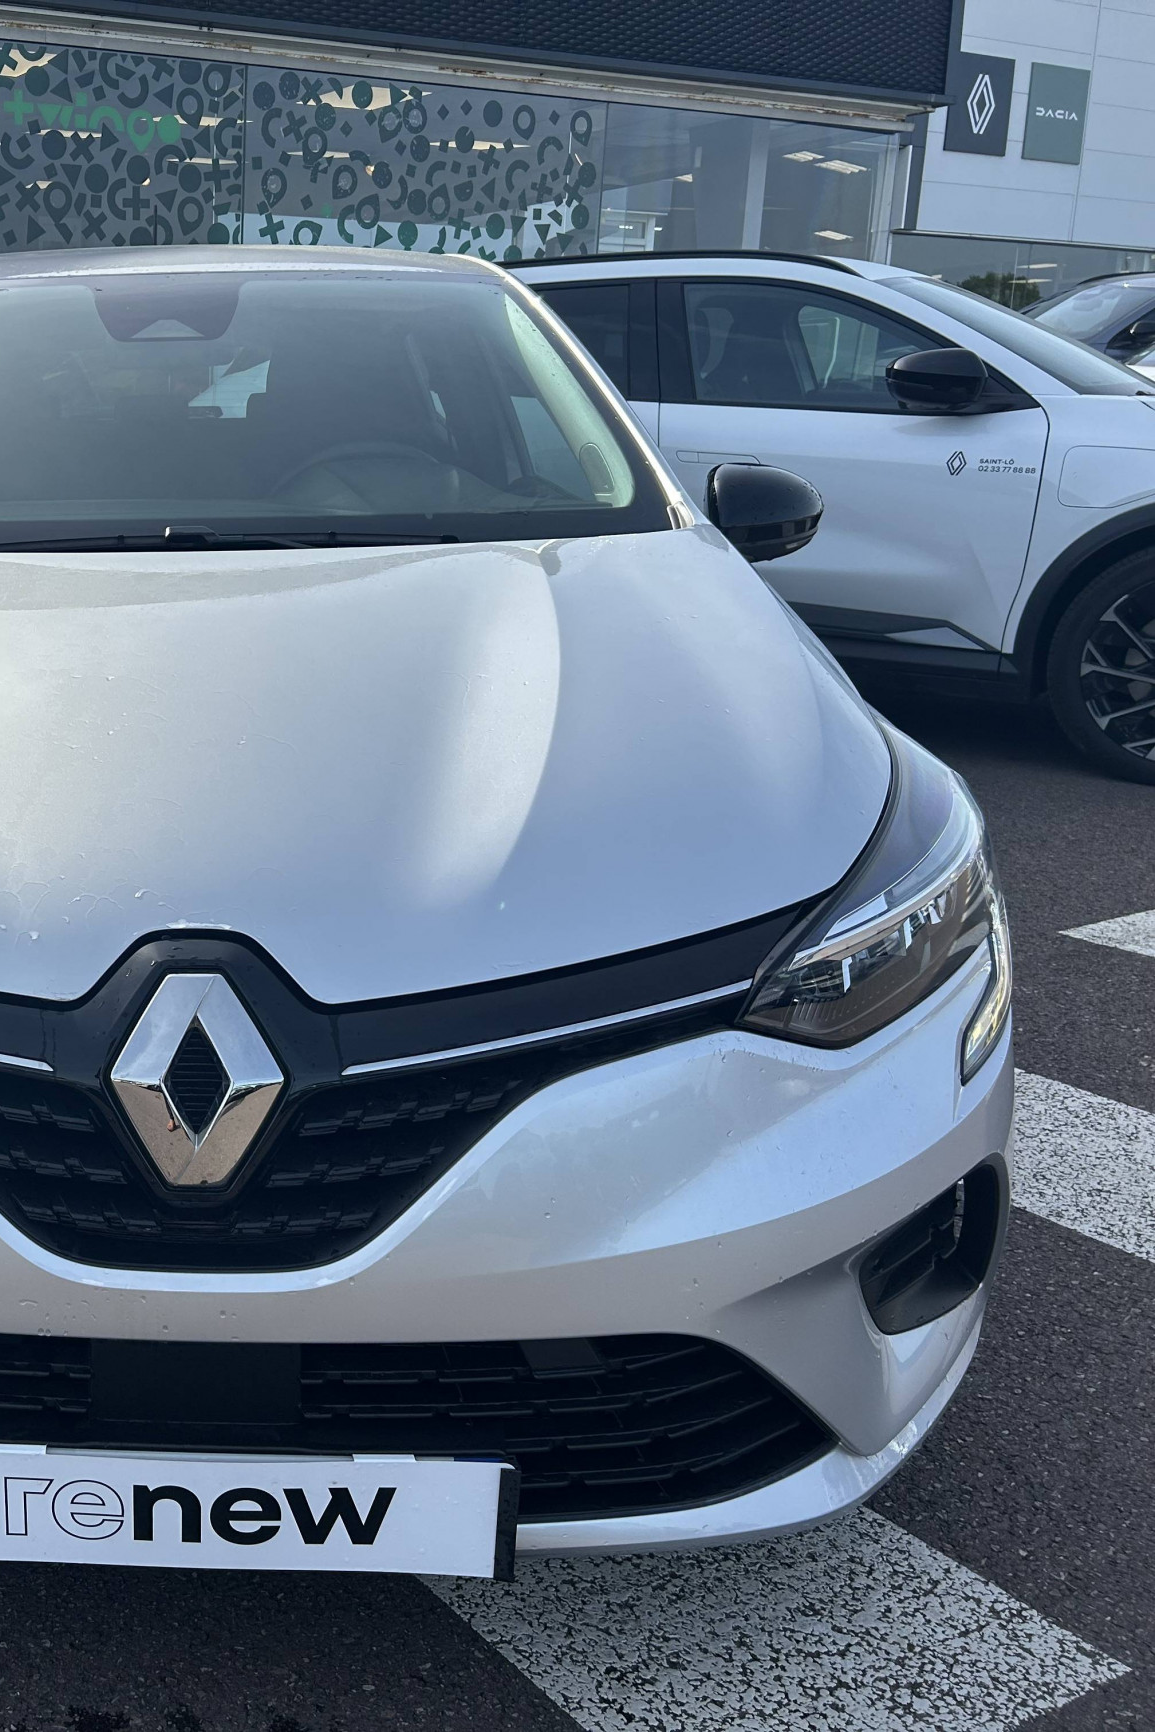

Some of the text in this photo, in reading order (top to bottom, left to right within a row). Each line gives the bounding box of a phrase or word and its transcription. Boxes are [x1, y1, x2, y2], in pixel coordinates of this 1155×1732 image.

[1035, 106, 1078, 121] DACIA
[977, 465, 989, 473] 02
[4, 1476, 398, 1546] renew
